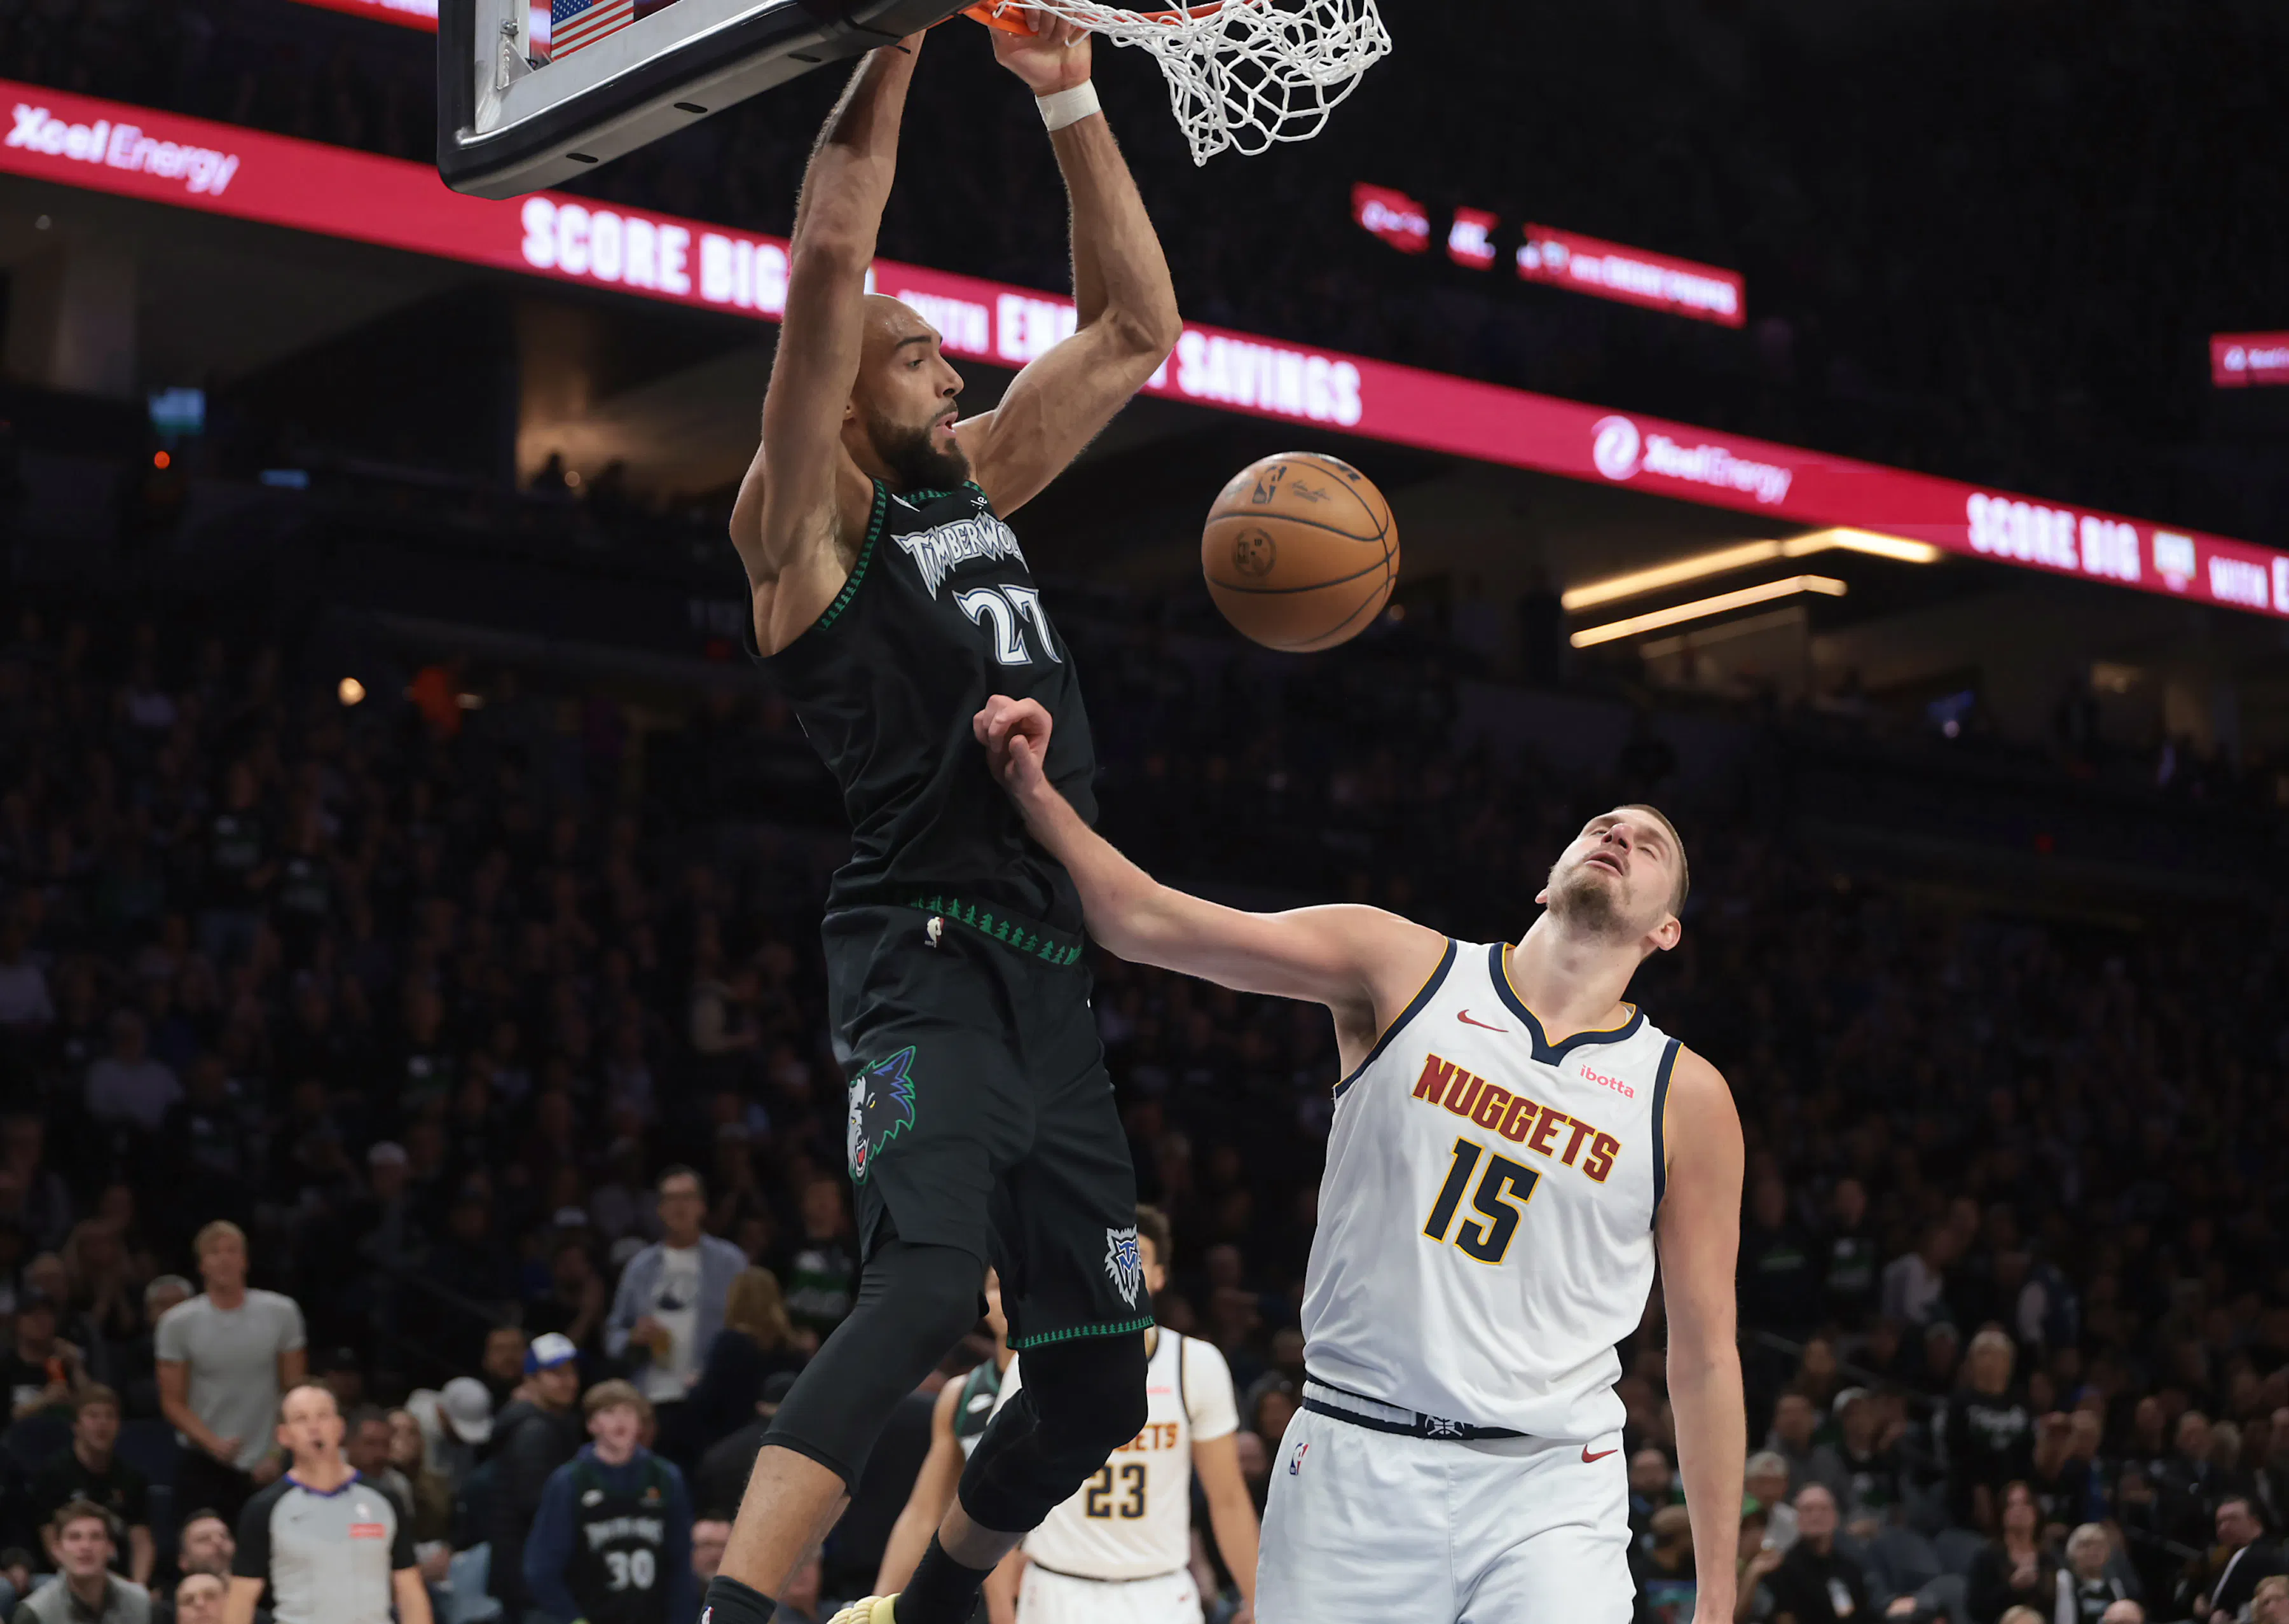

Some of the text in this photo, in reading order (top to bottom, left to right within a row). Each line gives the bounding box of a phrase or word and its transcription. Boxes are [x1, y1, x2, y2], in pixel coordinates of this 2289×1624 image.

[521, 196, 691, 295] SCORE
[700, 232, 790, 314] BIG
[1176, 330, 1363, 426] SAVINGS
[952, 584, 1062, 666] 27
[1411, 1052, 1621, 1184] NUGGETS
[1579, 1063, 1635, 1099] ibotta
[1422, 1135, 1543, 1265] 15
[1085, 1464, 1147, 1520] 23
[605, 1549, 656, 1590] 30
